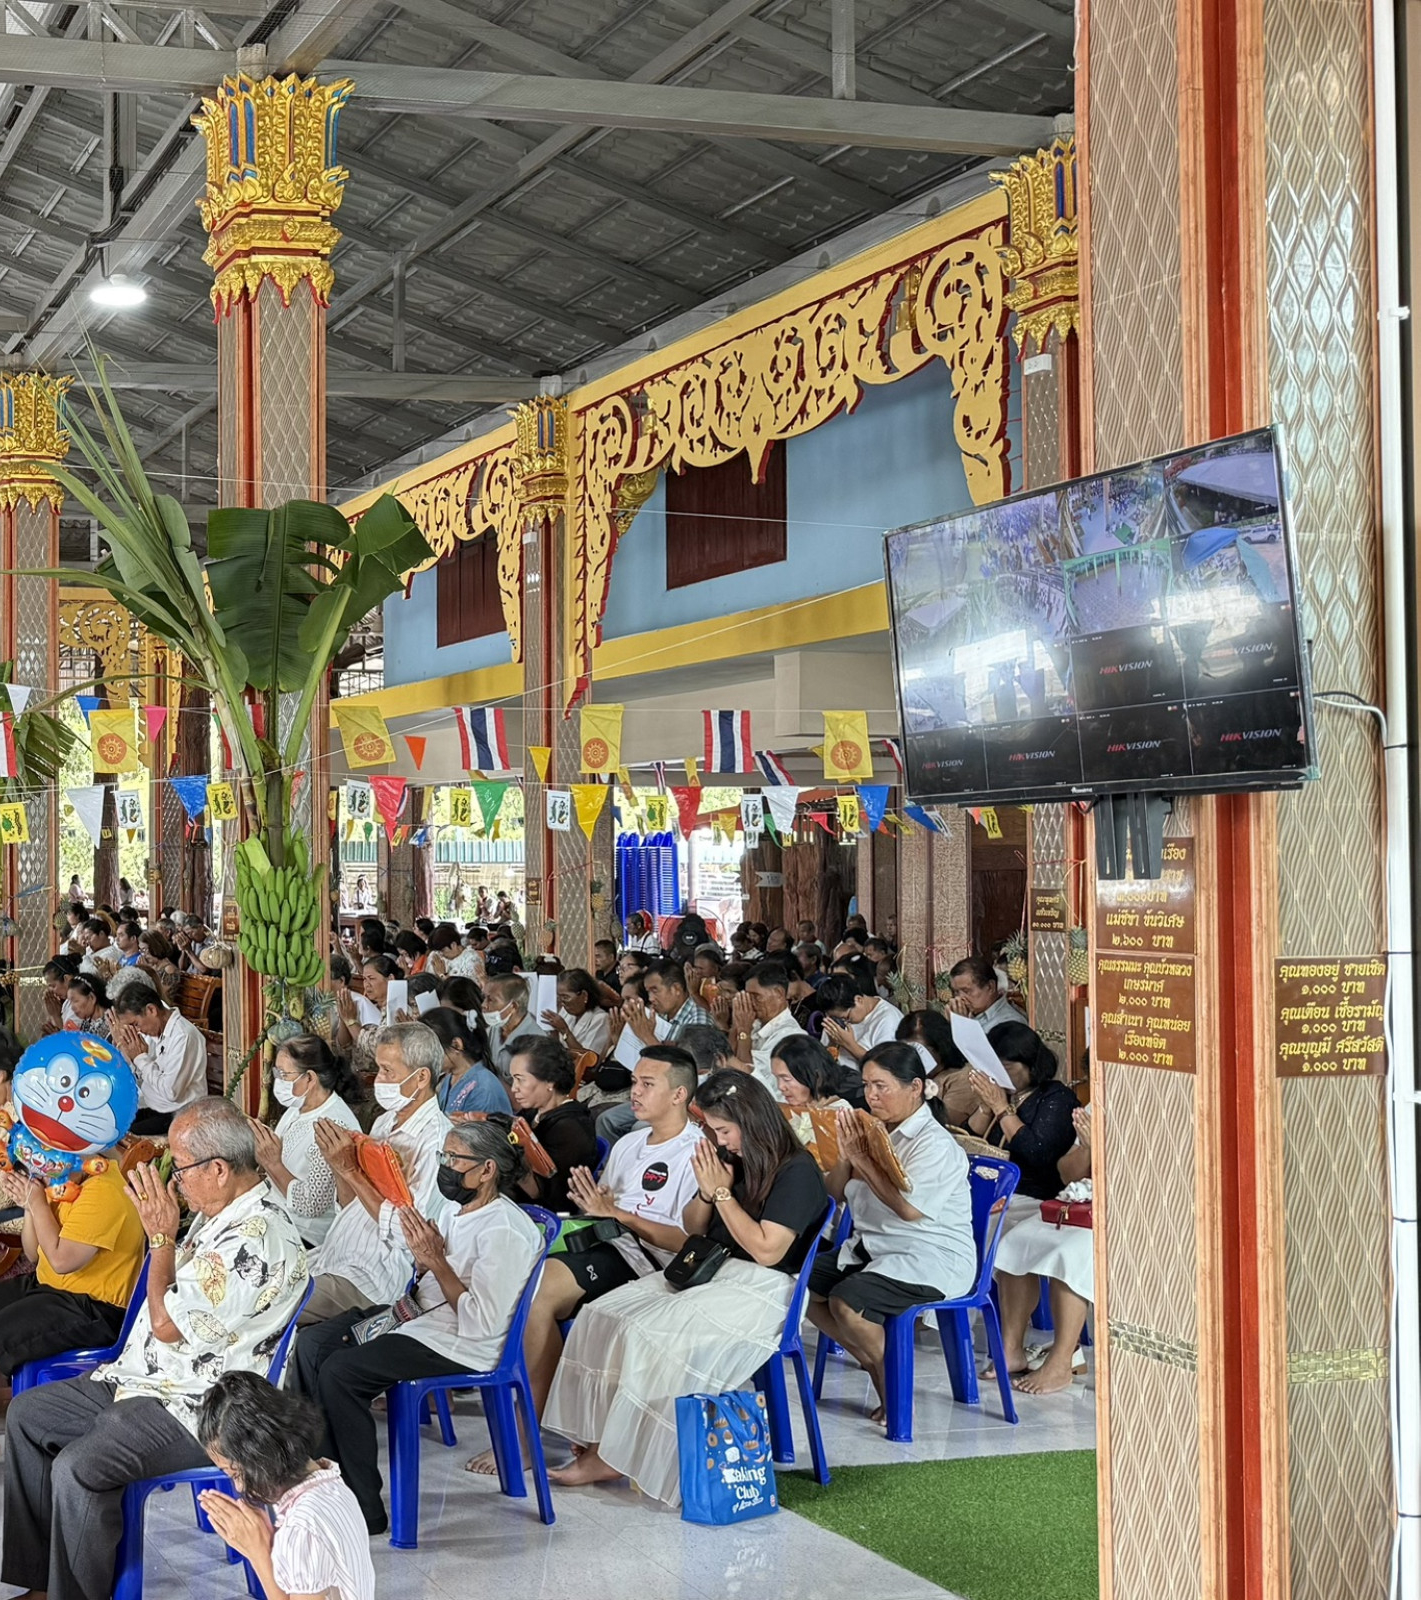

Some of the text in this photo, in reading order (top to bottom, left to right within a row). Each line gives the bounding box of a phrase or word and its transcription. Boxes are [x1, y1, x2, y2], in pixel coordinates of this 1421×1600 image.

[1099, 660, 1153, 675] HIKVISION
[1220, 728, 1282, 742] HIKVISION
[1106, 740, 1161, 752] HIKVISION
[1008, 750, 1056, 762] HIKVISION
[921, 759, 964, 770] HIKVISION
[1152, 934, 1174, 948] บาท
[1341, 981, 1365, 994] บาท
[1151, 996, 1171, 1009] บาท
[1342, 1020, 1366, 1032] บาท
[1153, 1052, 1173, 1066] บาท
[1343, 1057, 1367, 1070] บาท
[736, 1484, 759, 1500] Club
